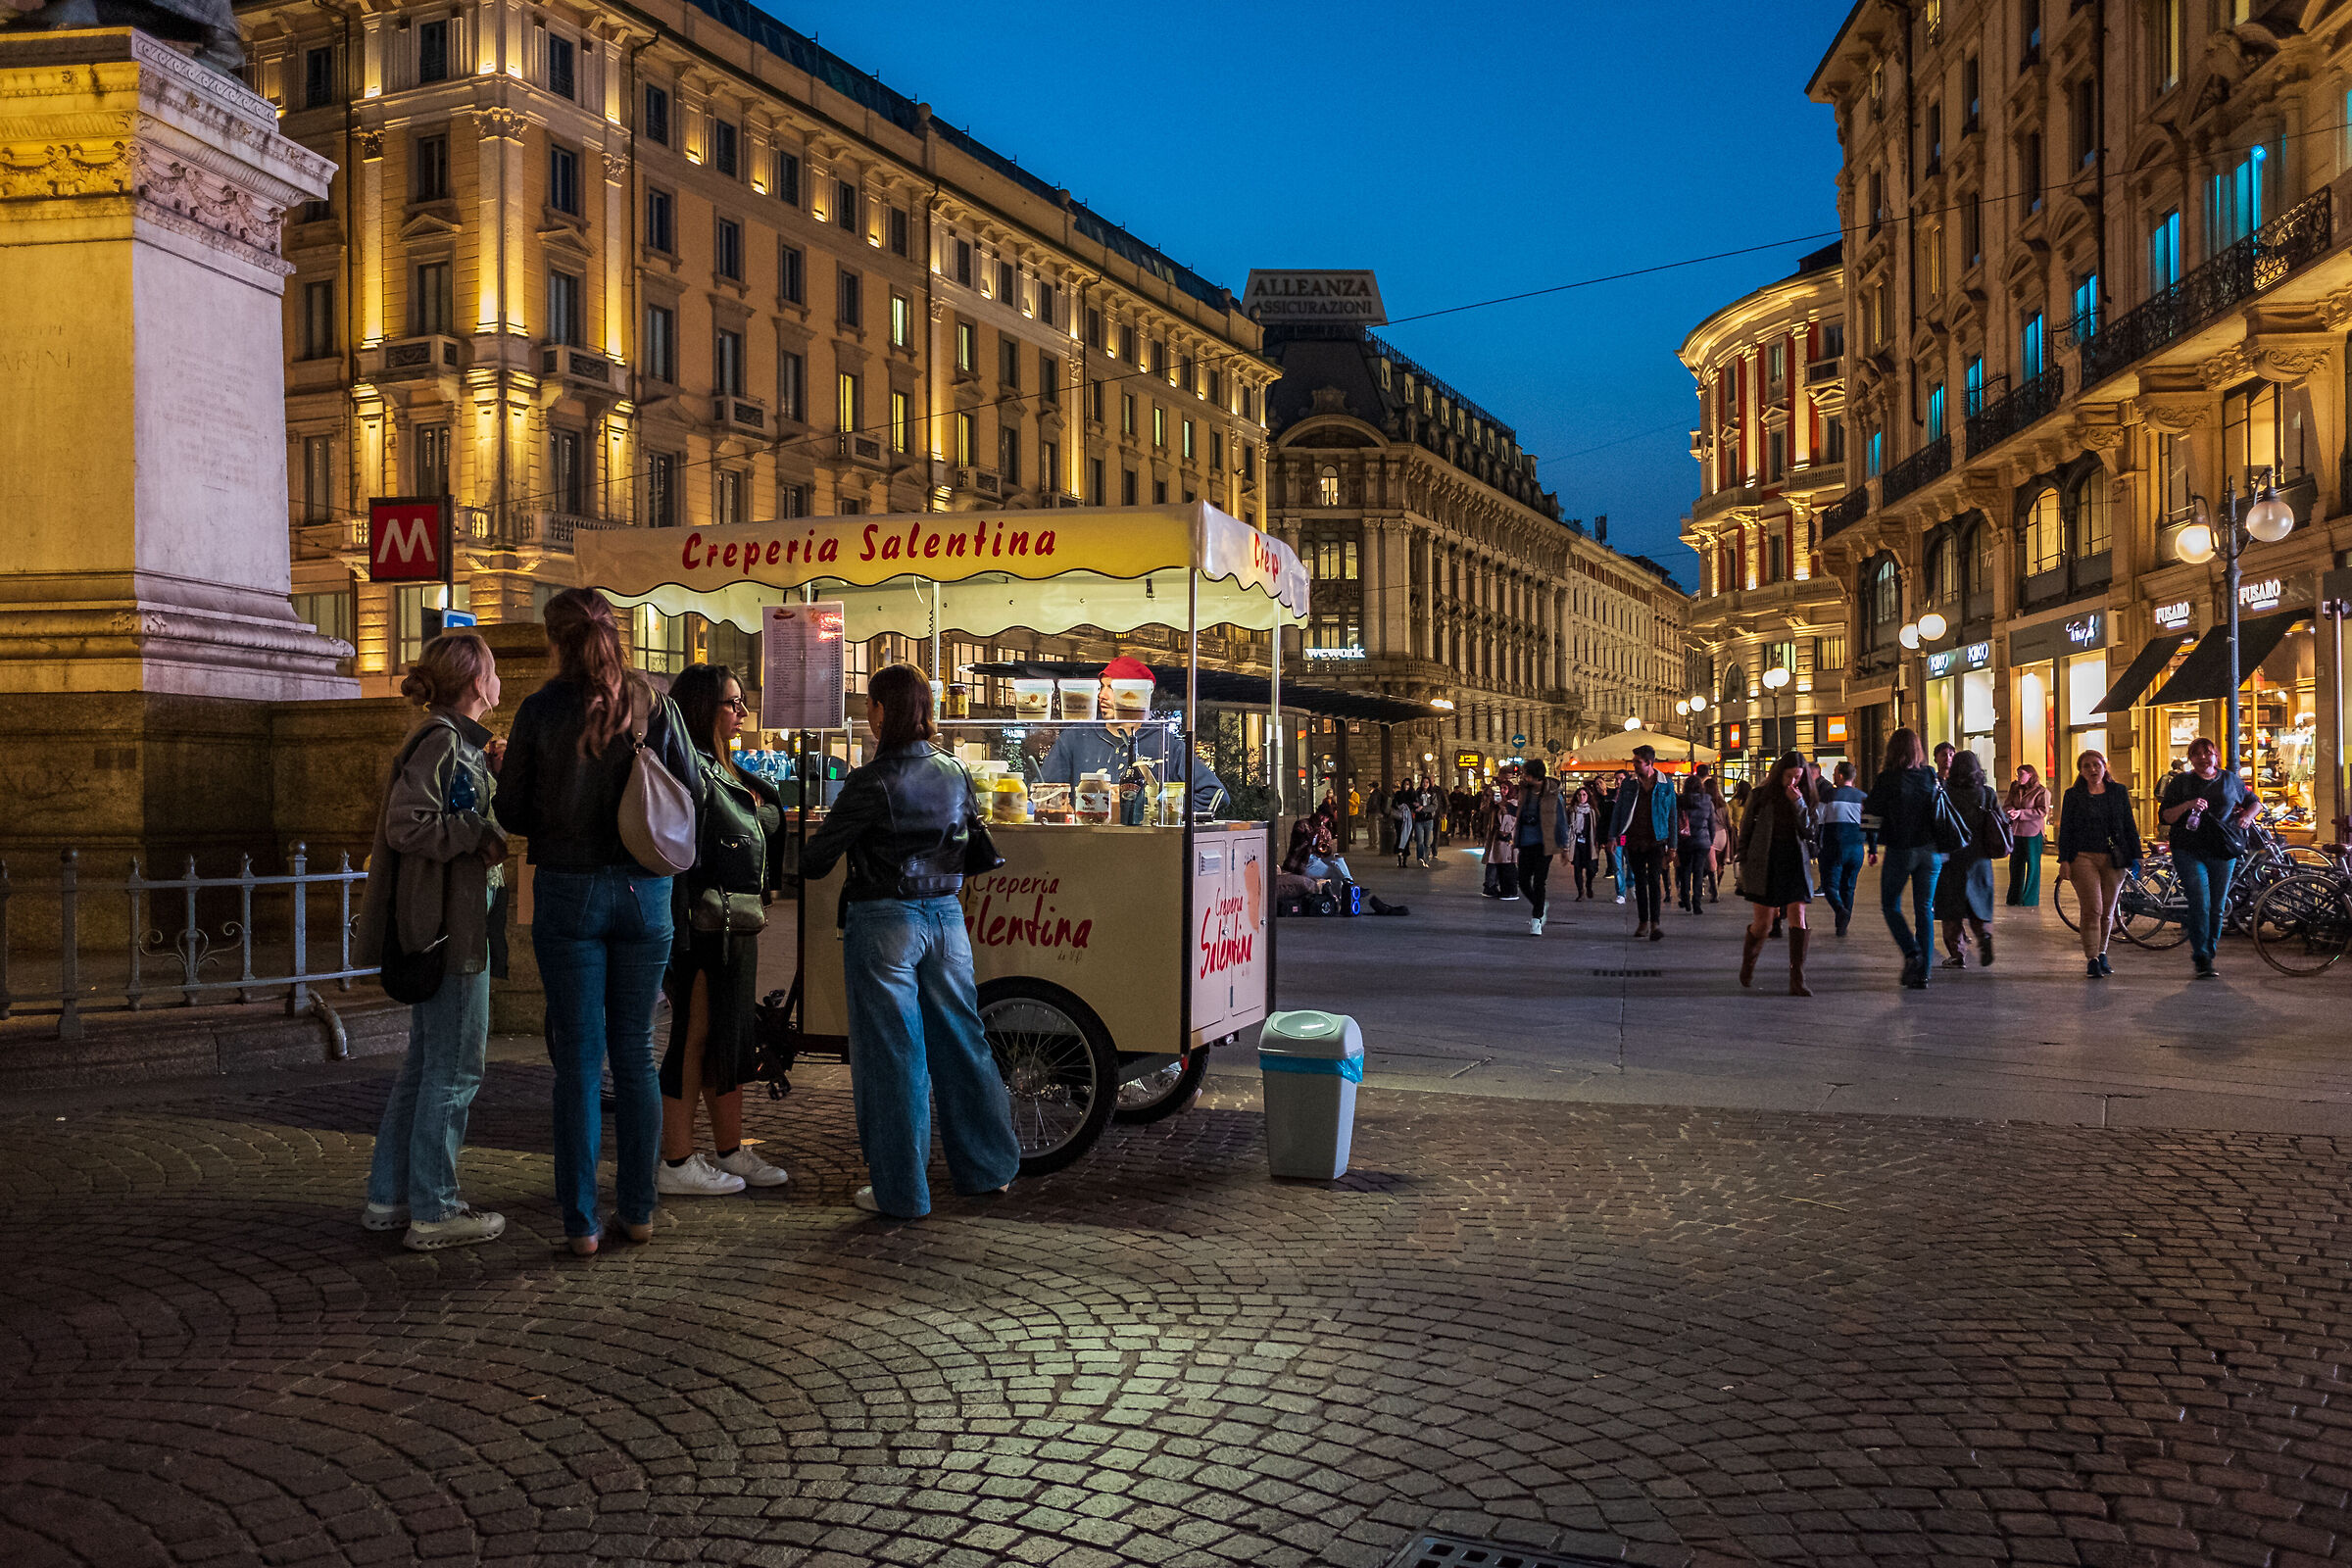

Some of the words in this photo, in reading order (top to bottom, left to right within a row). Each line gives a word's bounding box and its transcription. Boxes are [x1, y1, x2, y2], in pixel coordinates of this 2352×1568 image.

[1253, 278, 1372, 296] ALLEANZA
[1254, 300, 1372, 315] ASSICURAZIONI
[376, 517, 435, 564] M
[681, 530, 839, 574] Creperia
[860, 520, 1056, 561] Salentina
[1254, 532, 1282, 583] Crêp
[2238, 579, 2281, 606] FUSARO
[2155, 601, 2190, 624] FUSARO
[1304, 643, 1365, 659] wework
[1930, 654, 1949, 671] KIKO
[1967, 642, 1989, 663] KIKO
[973, 871, 1059, 902] Creperia
[964, 894, 1093, 949] lentina
[1200, 906, 1252, 980] Salentina
